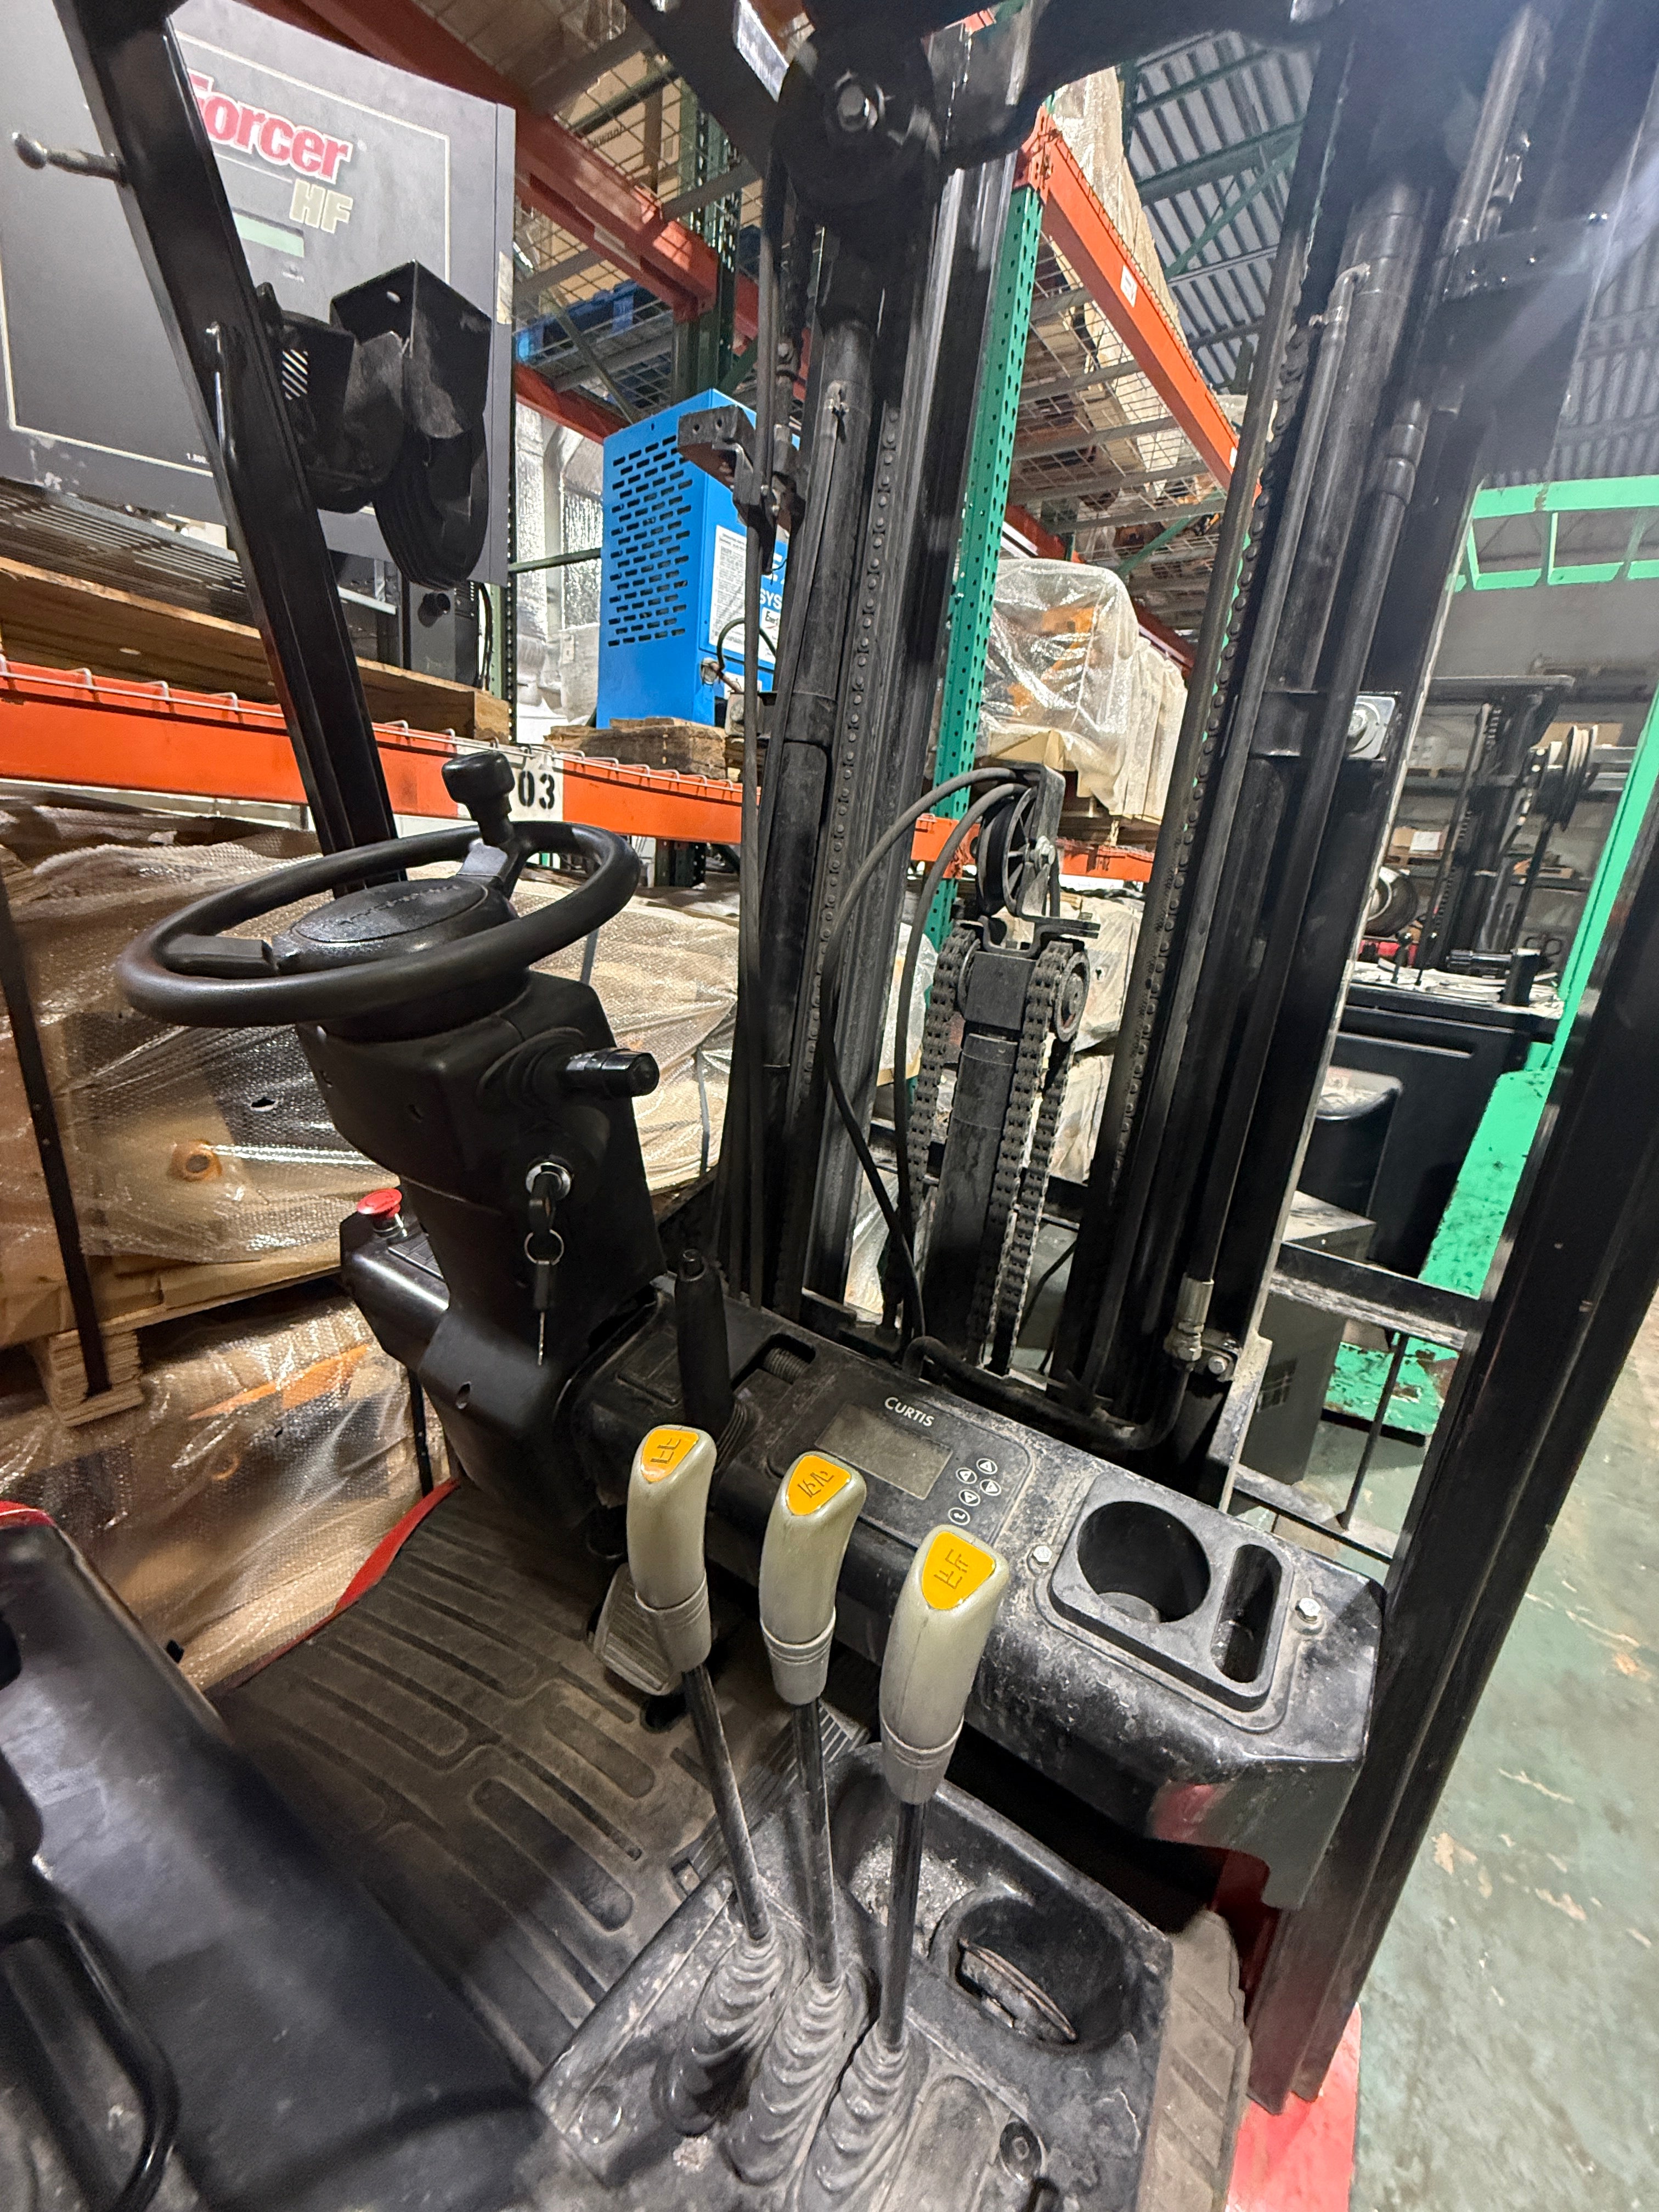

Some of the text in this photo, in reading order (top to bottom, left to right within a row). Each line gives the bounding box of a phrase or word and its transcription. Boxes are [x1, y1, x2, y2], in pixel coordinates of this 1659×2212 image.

[290, 178, 353, 234] HF
[518, 771, 555, 809] 03
[884, 1396, 935, 1427] CURTIS
